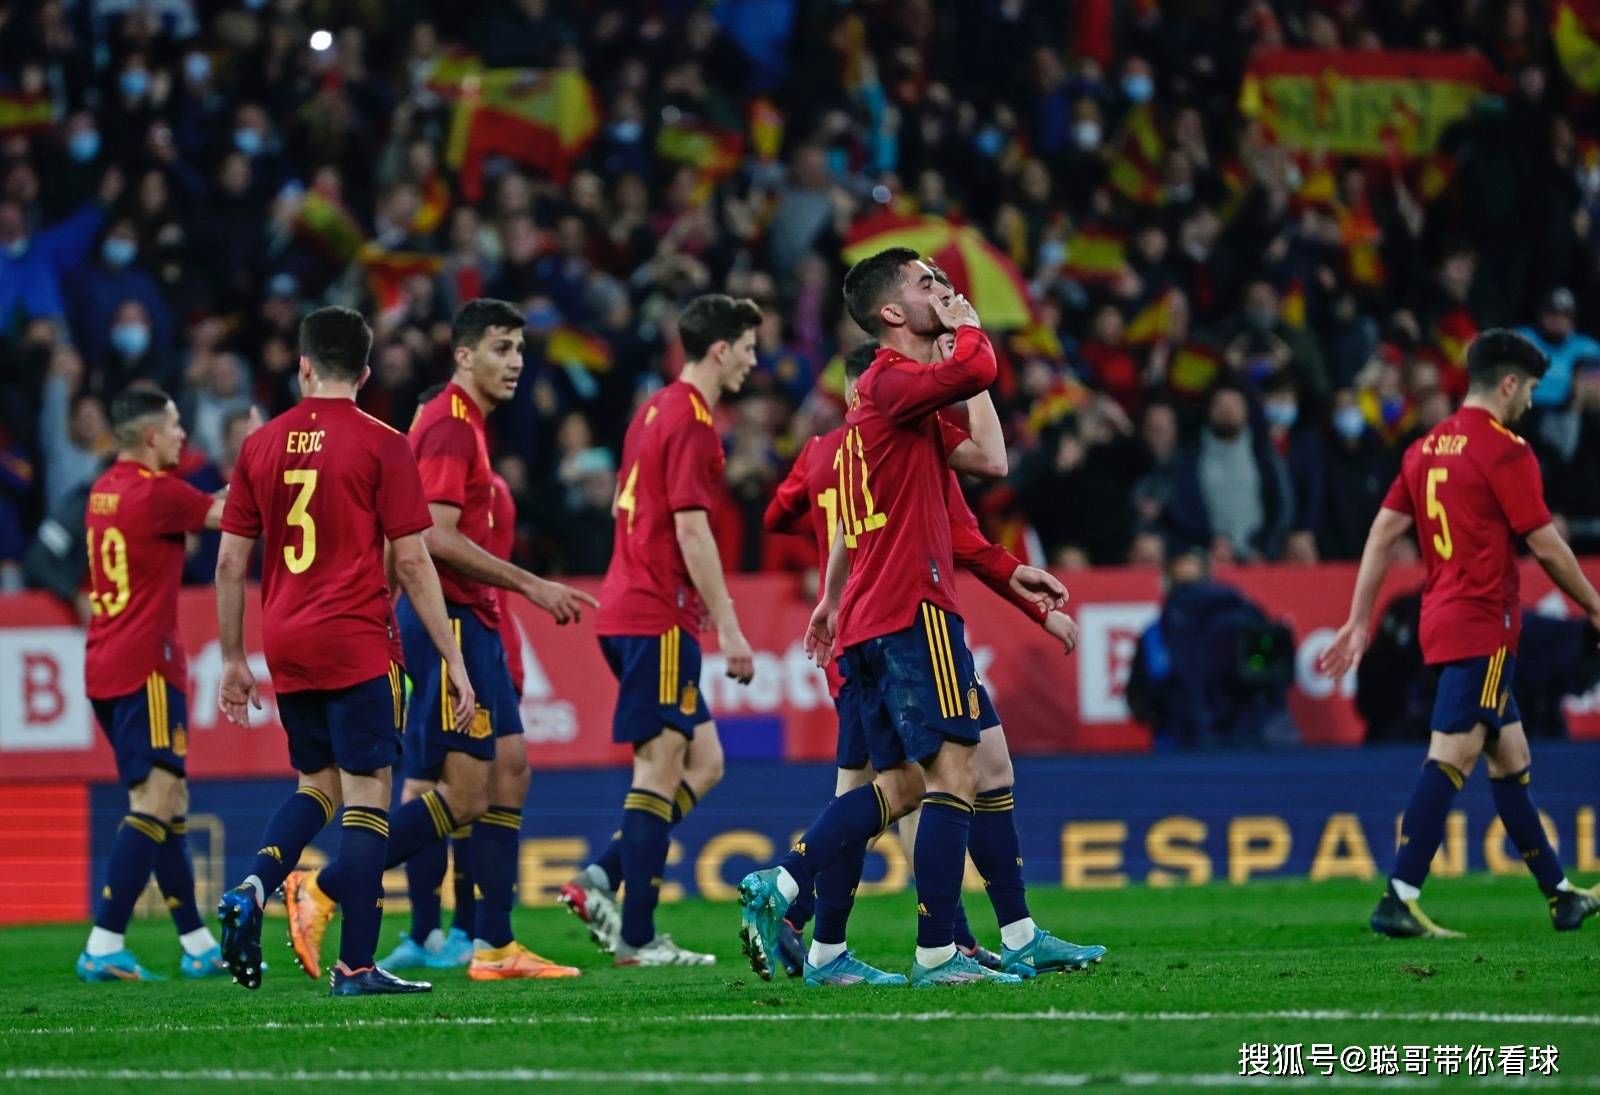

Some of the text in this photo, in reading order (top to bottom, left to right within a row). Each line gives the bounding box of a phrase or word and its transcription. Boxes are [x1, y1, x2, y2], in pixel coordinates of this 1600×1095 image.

[286, 430, 326, 454] ERIC
[283, 469, 318, 575] 3
[1426, 467, 1453, 561] 5
[86, 526, 130, 617] 19
[22, 651, 66, 725] B
